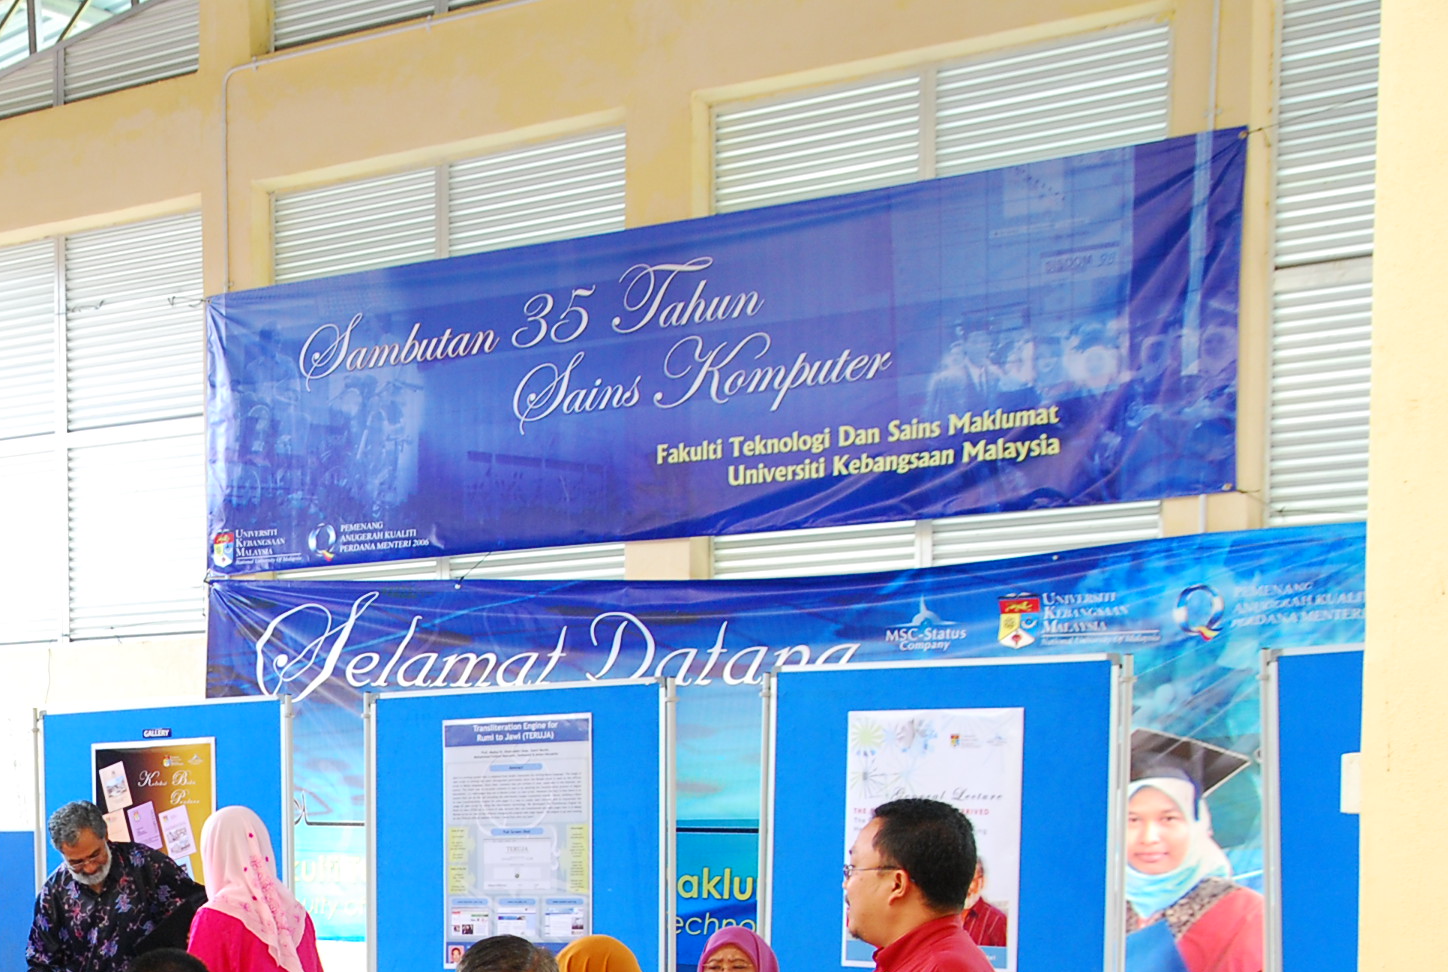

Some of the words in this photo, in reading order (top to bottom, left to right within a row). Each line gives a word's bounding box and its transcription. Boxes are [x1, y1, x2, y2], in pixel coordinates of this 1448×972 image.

[299, 312, 500, 392] Sambutan
[511, 284, 596, 349] 35
[612, 256, 765, 334] Tahun
[512, 351, 642, 436] Sains
[653, 332, 893, 412] Komputer
[656, 438, 723, 465] Fakulti
[728, 427, 831, 458] Teknologi
[838, 425, 881, 447] Dan
[887, 418, 942, 442] Sains
[947, 405, 1060, 436] Maklumat
[728, 457, 825, 487] Universiti
[832, 448, 955, 478] Kebangsaan
[961, 433, 1061, 463] Malaysia
[235, 528, 278, 538] UNIVERSITI
[340, 521, 384, 532] PEMENANG
[340, 531, 384, 542] ANUGERAH
[385, 529, 417, 539] KUALITI
[235, 547, 273, 557] MALAYSIA
[340, 542, 375, 553] PERDANA
[377, 540, 412, 550] MENTERI
[413, 538, 430, 548] 2006
[1042, 592, 1117, 606] UNIVERSITI
[1042, 618, 1107, 633] MALAYSIA
[885, 627, 967, 641] MSC-Status
[256, 591, 566, 702] Selamat
[899, 640, 951, 652] Company
[473, 722, 522, 732] Transliteration
[523, 721, 546, 731] Engine
[547, 720, 558, 729] for
[143, 729, 170, 738] GALLERY
[477, 733, 494, 742] Rumi
[495, 733, 503, 741] to
[504, 732, 521, 741] Jawi
[522, 731, 554, 741] (TERUJA)
[952, 787, 1003, 801] Lecture
[677, 866, 758, 901] aklu
